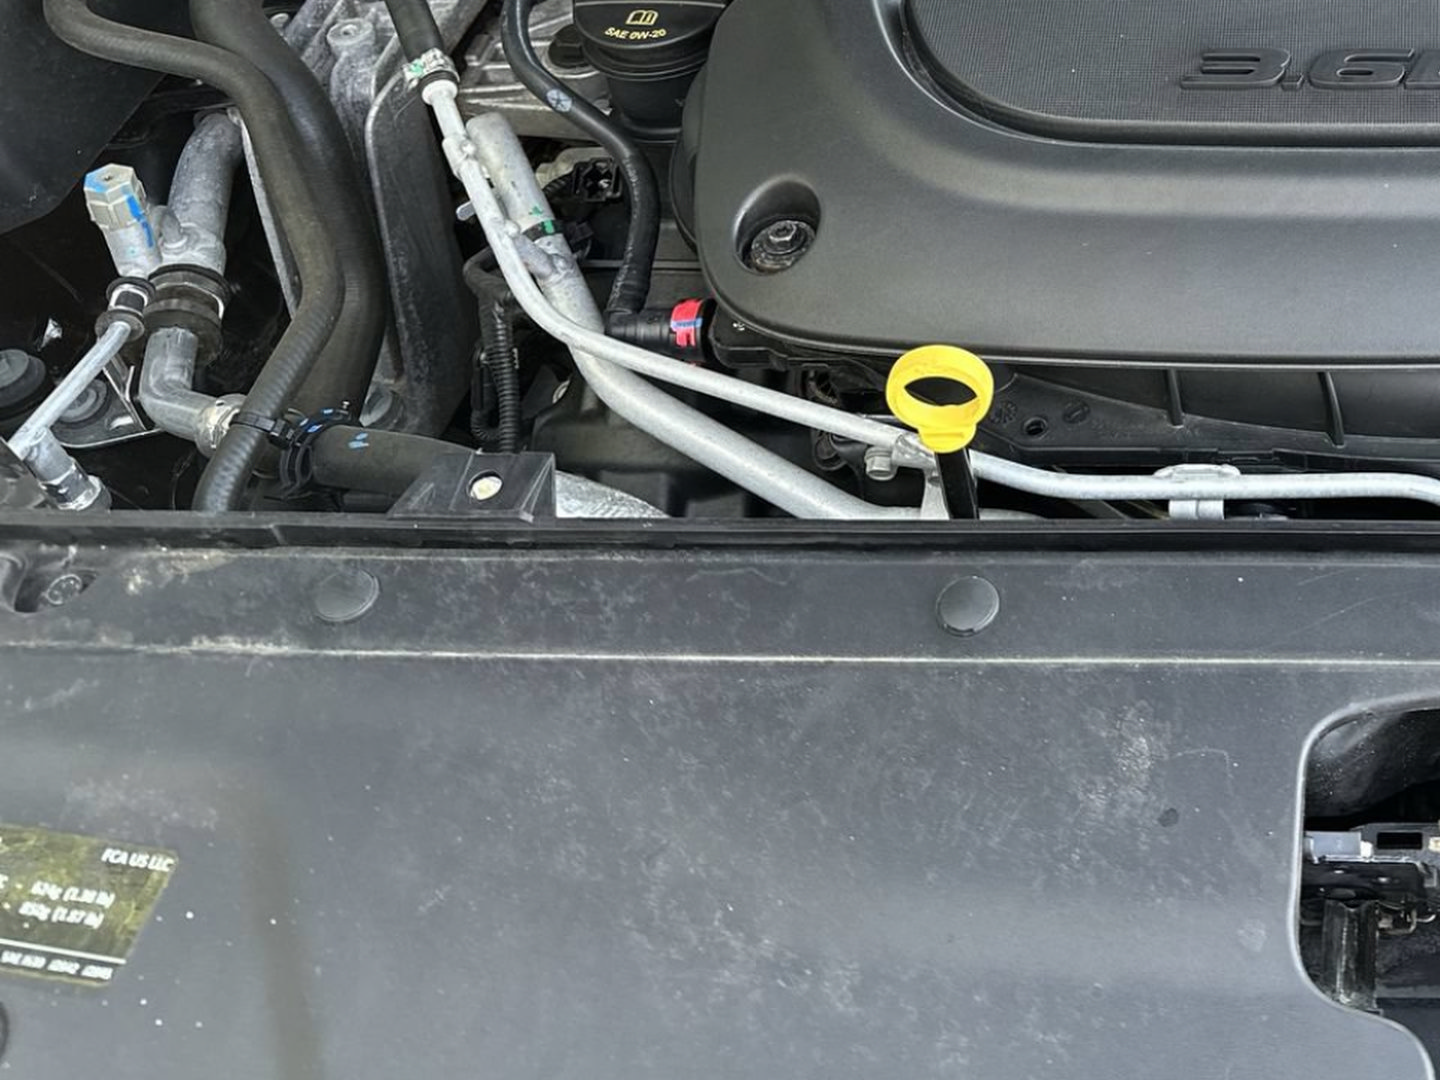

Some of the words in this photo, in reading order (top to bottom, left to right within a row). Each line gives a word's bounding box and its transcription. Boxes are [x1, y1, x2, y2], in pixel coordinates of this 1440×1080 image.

[604, 27, 629, 39] SAE
[629, 28, 667, 39] 0W-20
[101, 848, 129, 865] FCA
[128, 852, 150, 868] US
[148, 854, 175, 872] LLC
